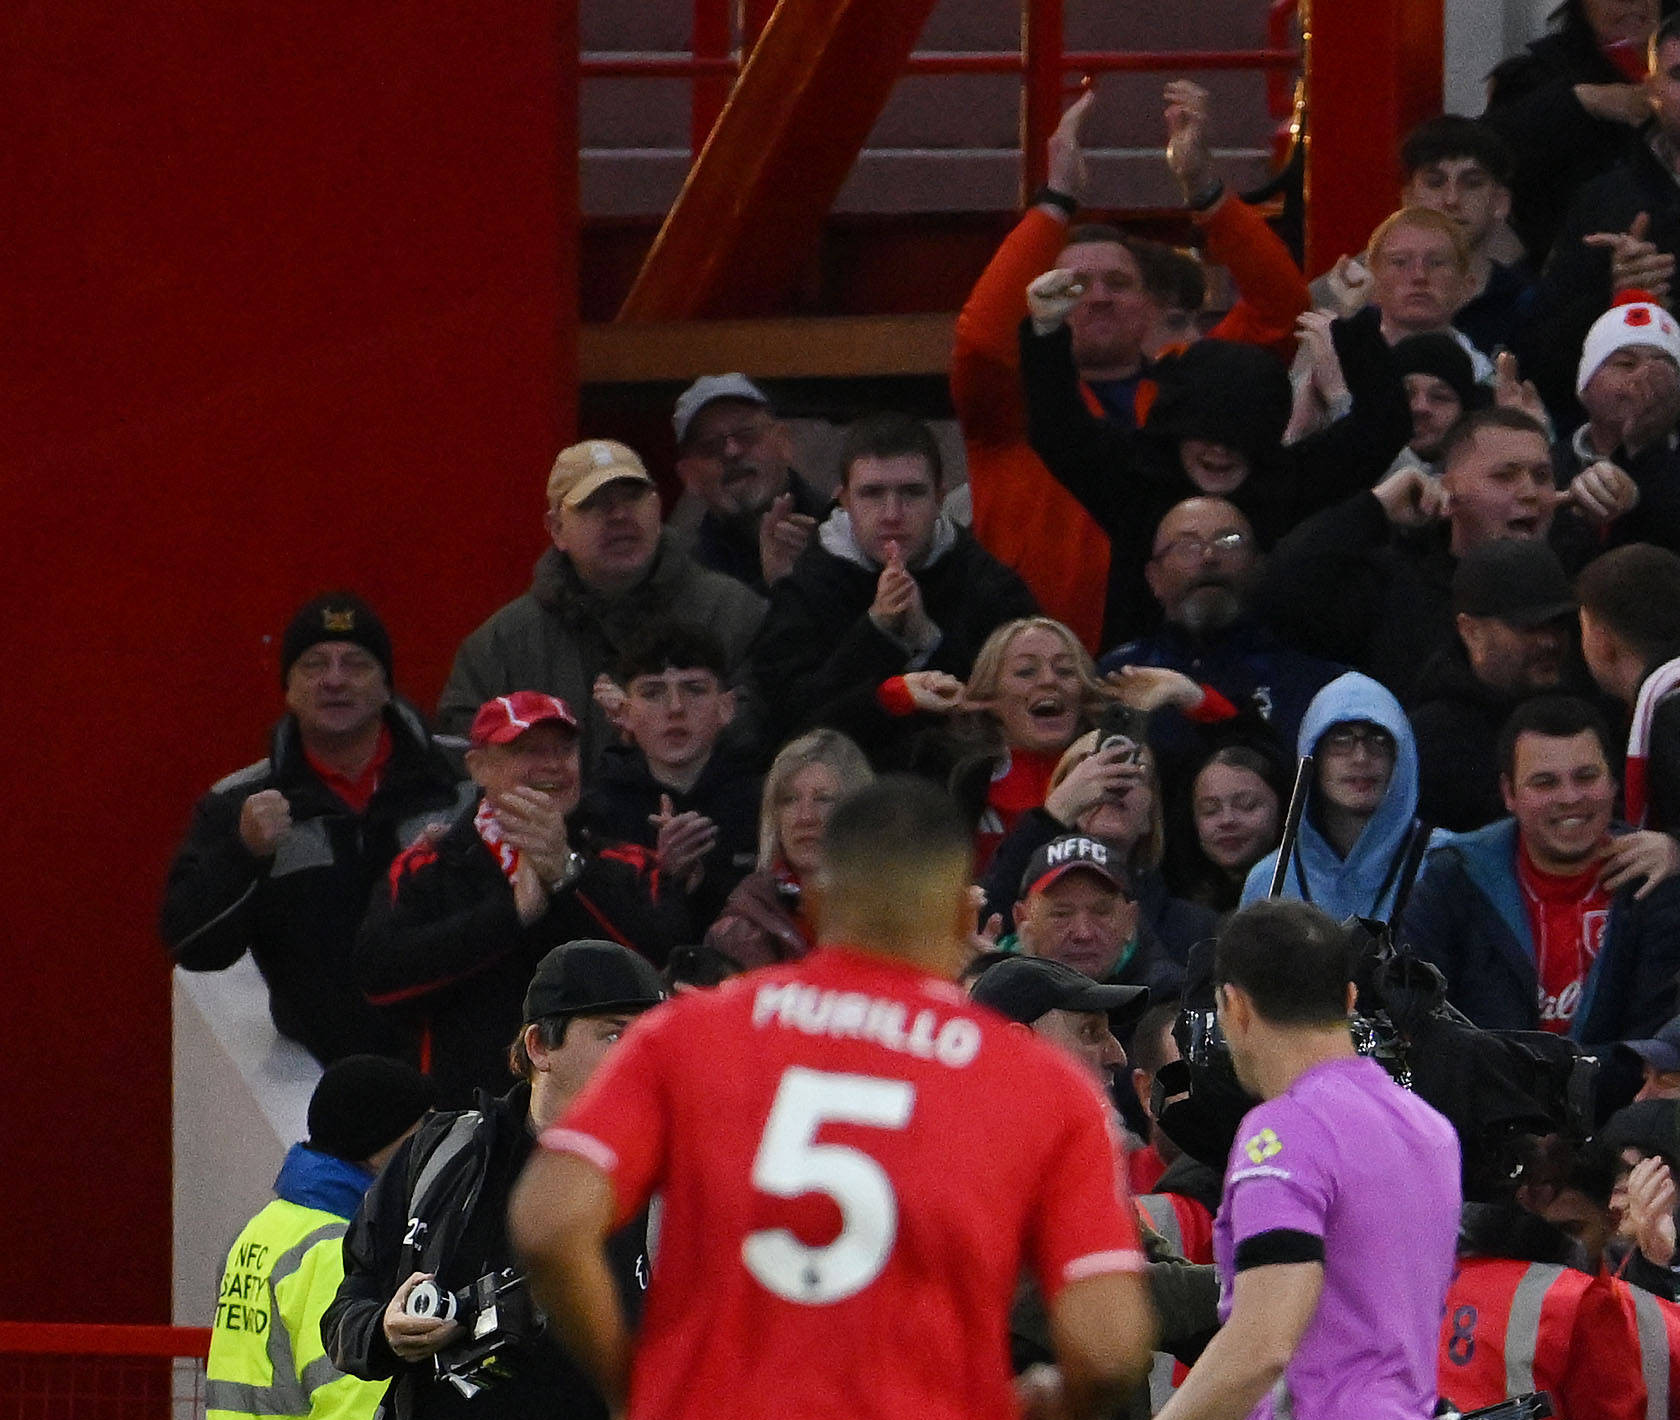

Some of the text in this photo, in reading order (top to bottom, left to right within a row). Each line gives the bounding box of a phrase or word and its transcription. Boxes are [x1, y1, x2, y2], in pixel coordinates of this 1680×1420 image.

[1047, 838, 1107, 866] NFFC
[752, 983, 982, 1069] MURILLO
[741, 1065, 917, 1305] 5
